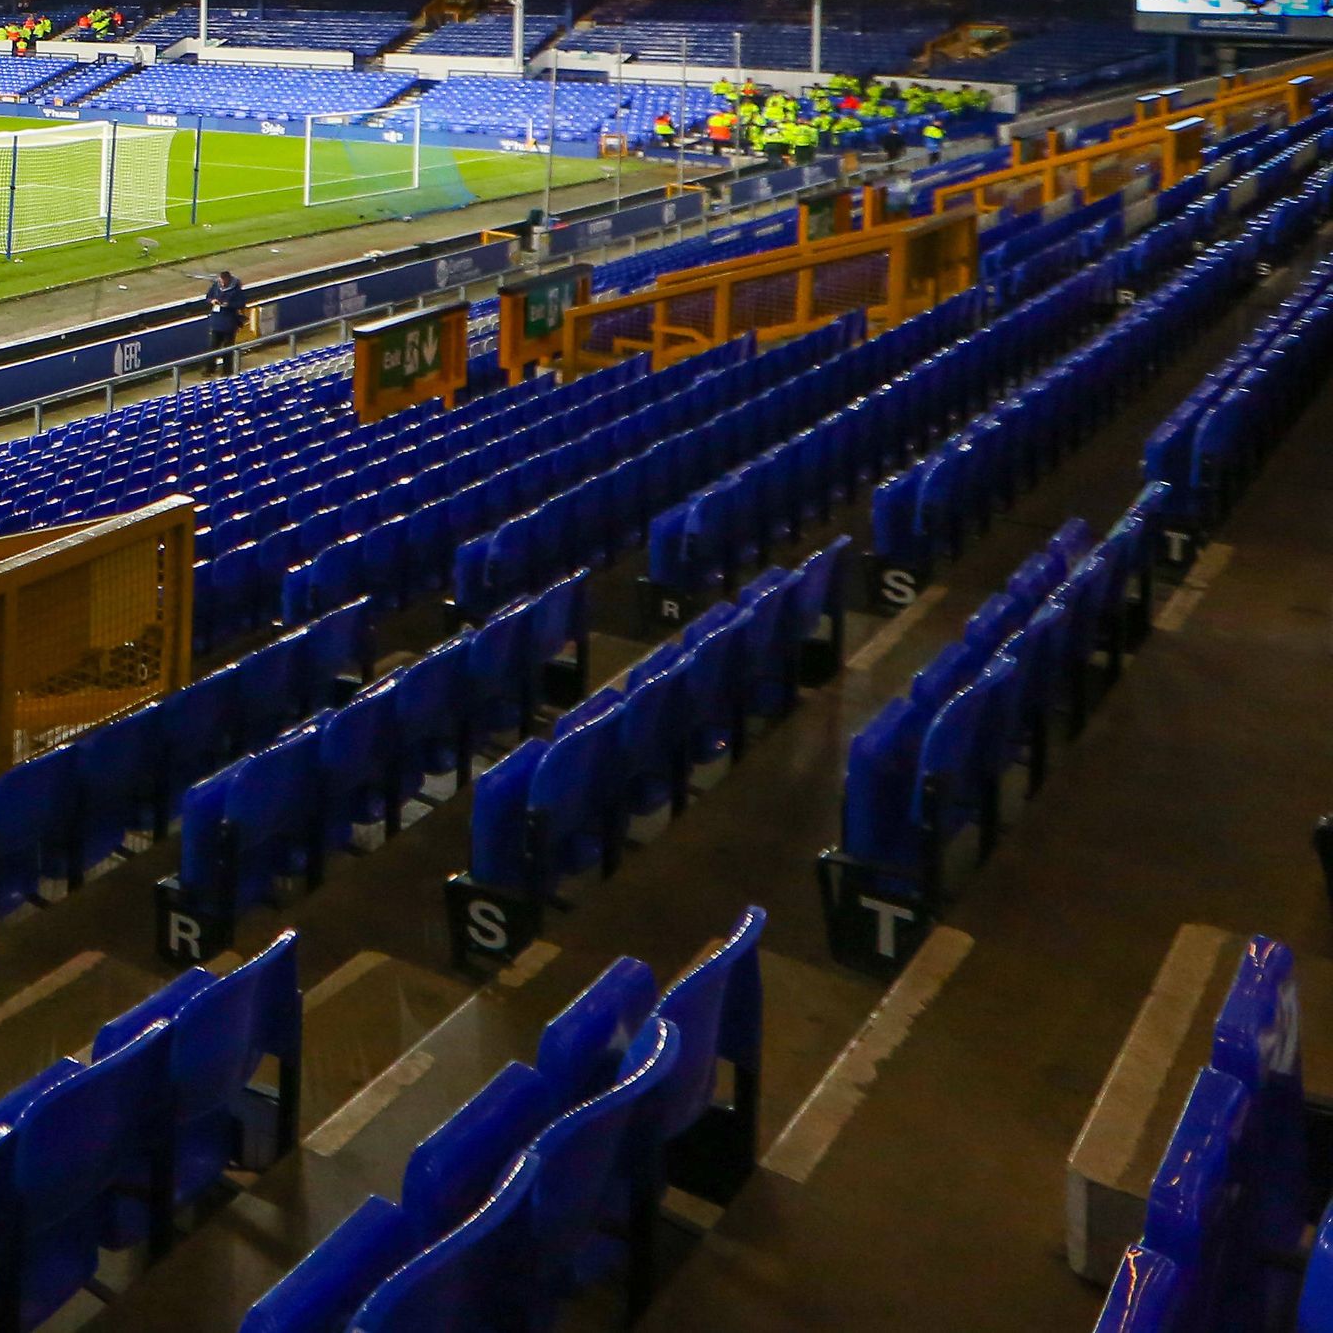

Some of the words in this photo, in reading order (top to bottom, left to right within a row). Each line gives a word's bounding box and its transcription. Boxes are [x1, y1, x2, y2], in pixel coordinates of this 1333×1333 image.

[147, 114, 177, 126] KICK
[1163, 530, 1188, 562] T
[883, 569, 917, 604] S
[662, 599, 679, 619] R
[169, 911, 201, 960] R
[467, 899, 508, 950] S
[860, 894, 915, 960] T
